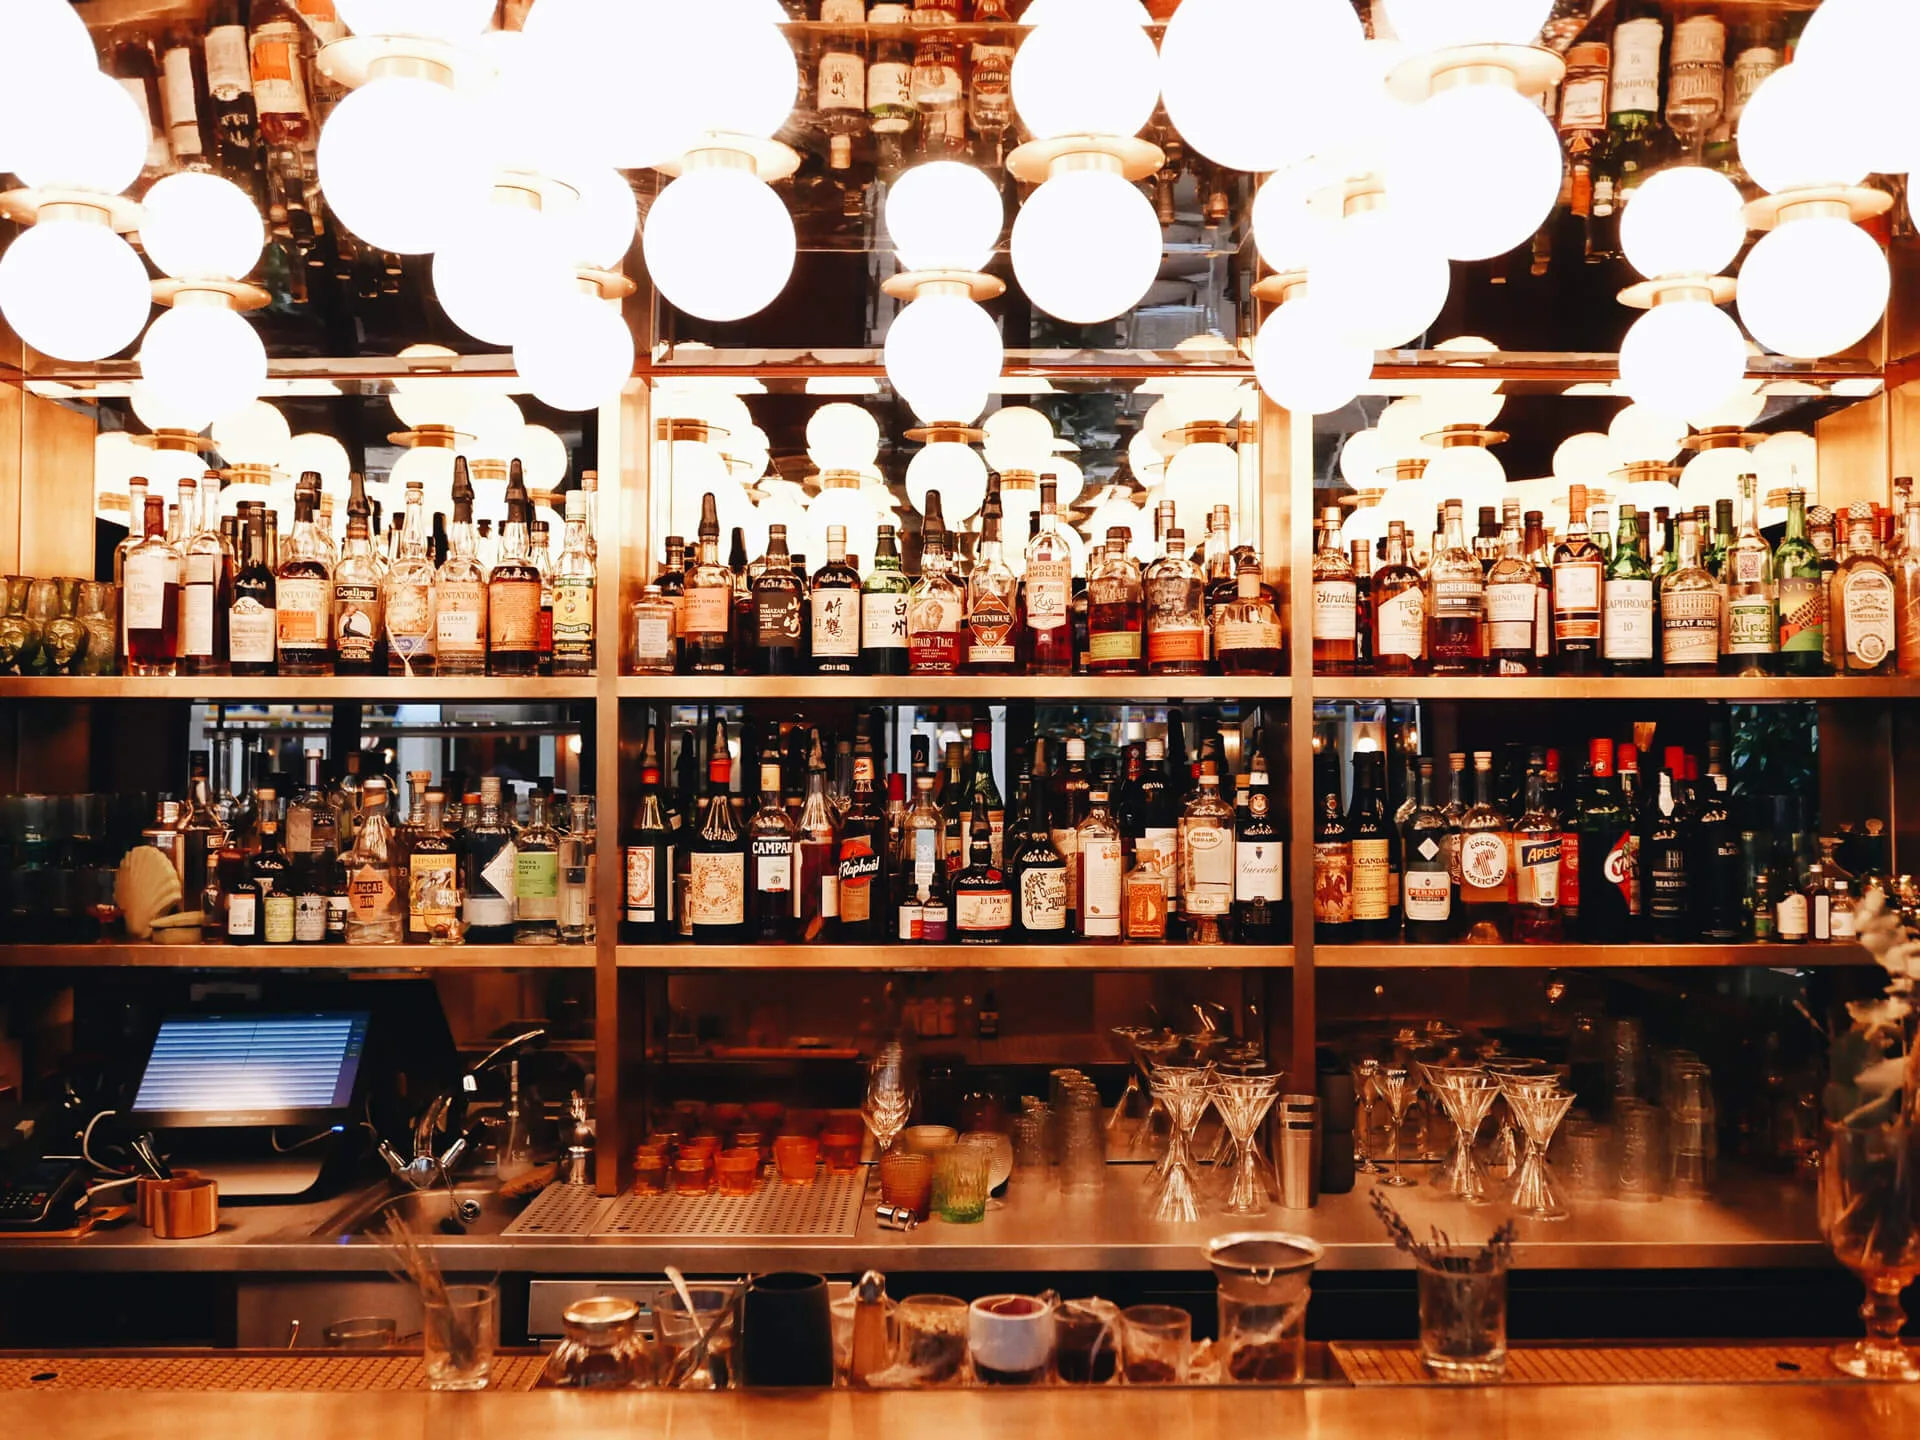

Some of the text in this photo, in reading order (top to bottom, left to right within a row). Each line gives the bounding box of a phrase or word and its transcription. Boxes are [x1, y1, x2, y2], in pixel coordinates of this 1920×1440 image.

[336, 587, 374, 600] Goslings
[824, 597, 843, 638] 竹鶴
[891, 597, 908, 638] 白州
[1666, 618, 1716, 628] GREAT KING
[911, 636, 954, 648] UFFALO TRACE
[1470, 840, 1498, 850] COCCHI
[1527, 846, 1562, 864] APERO
[1465, 869, 1505, 885] AMERICANO
[1409, 888, 1447, 896] PERNOD
